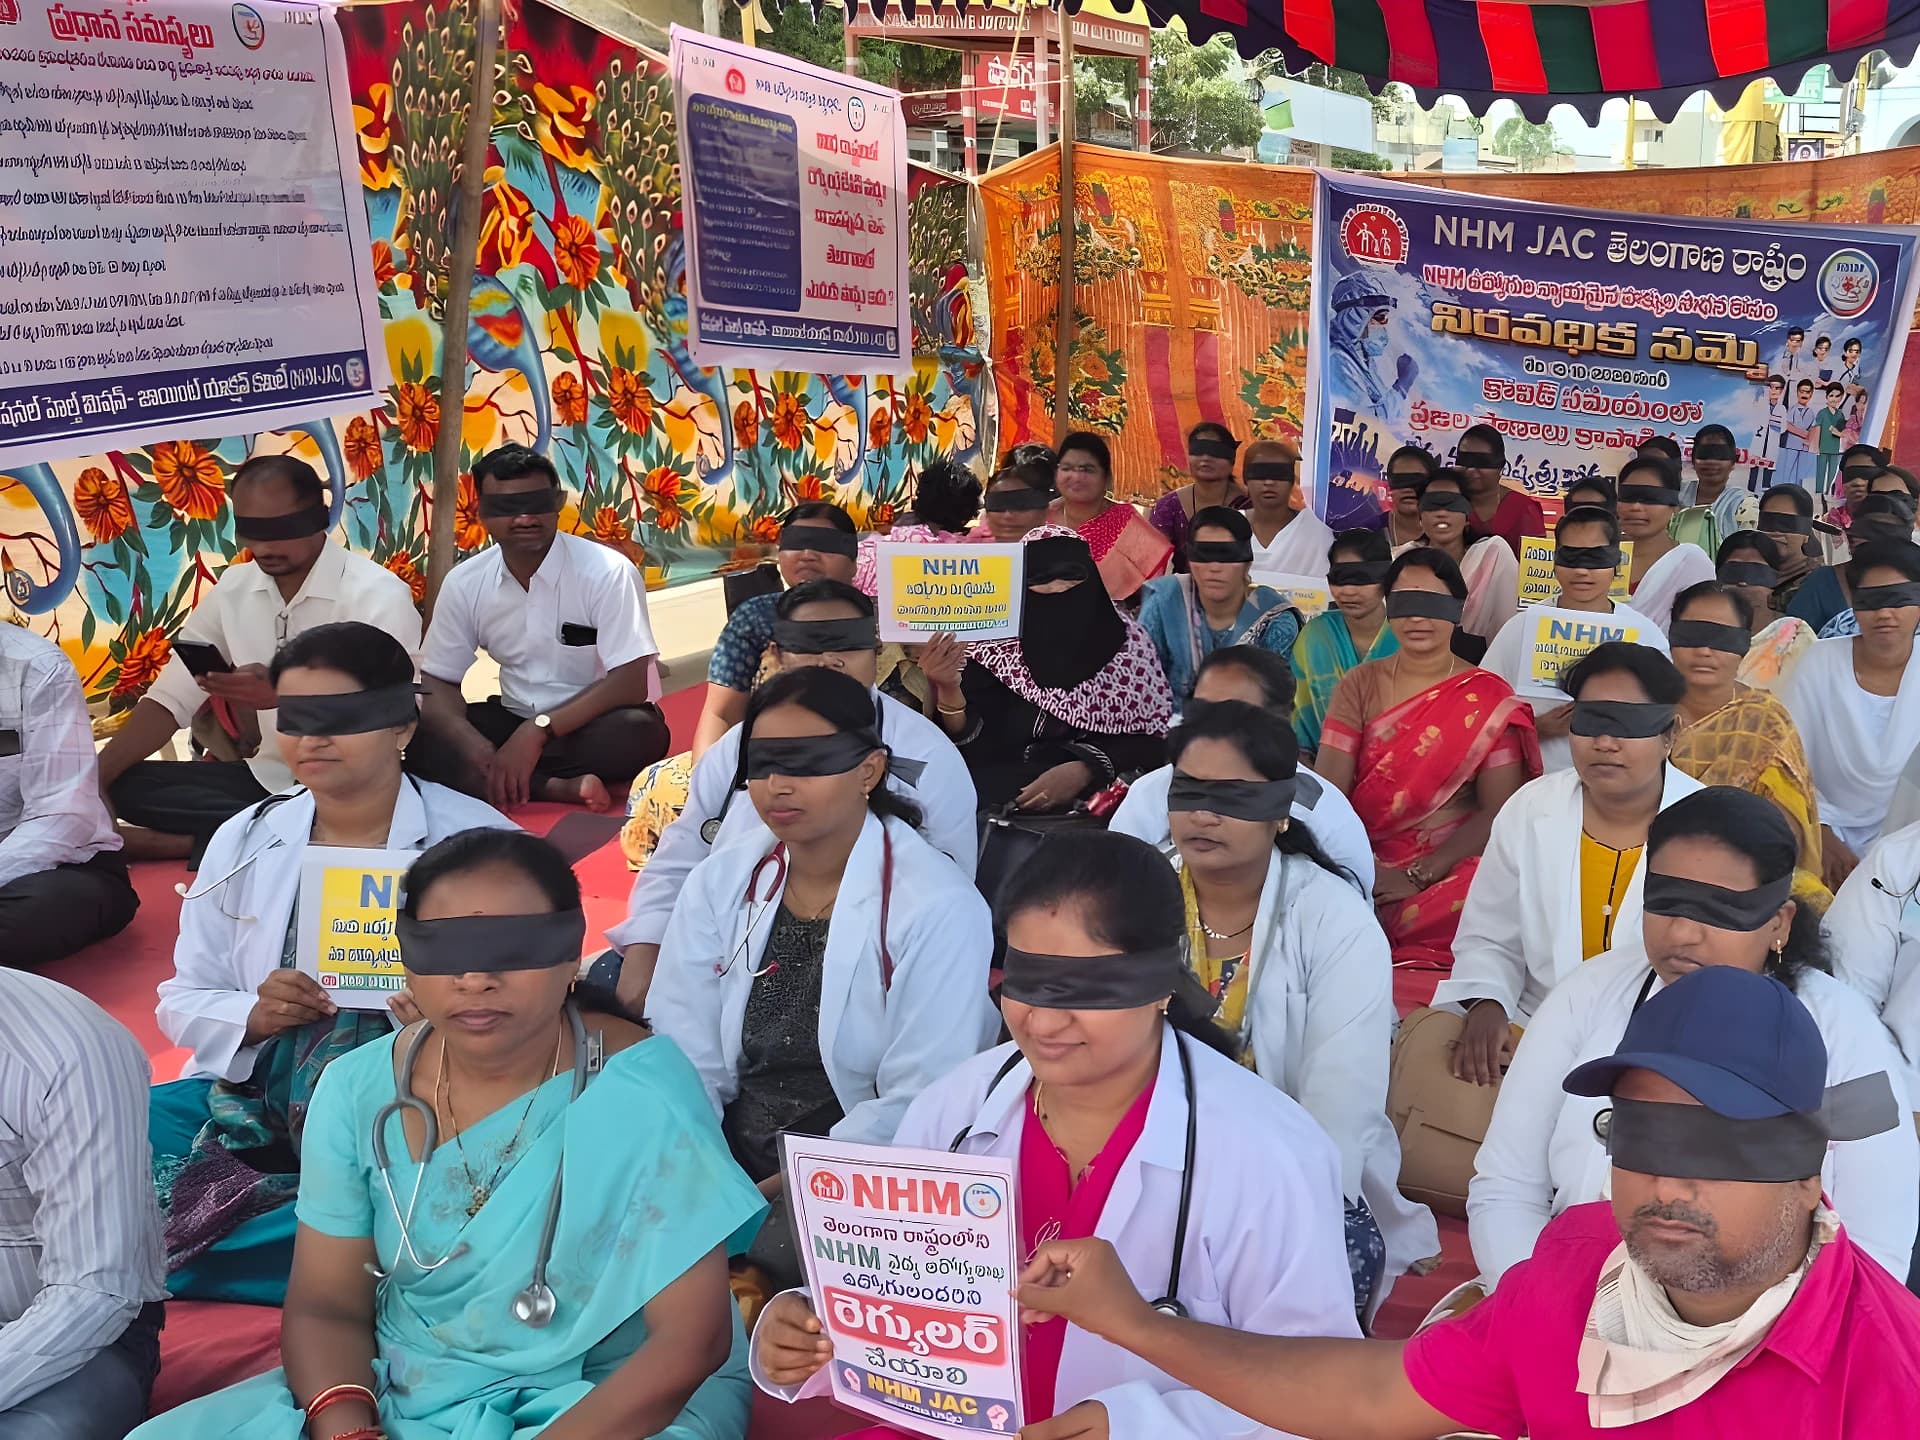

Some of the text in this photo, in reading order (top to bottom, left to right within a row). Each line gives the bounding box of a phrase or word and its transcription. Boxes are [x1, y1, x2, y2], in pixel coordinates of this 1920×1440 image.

[47, 3, 215, 59] ప్రధాన సమస్యలు
[1434, 214, 1515, 253] NHM
[1526, 225, 1597, 260] JAC
[1606, 231, 1725, 274] తెలంగాణ
[1423, 265, 1466, 290] NHM
[1430, 302, 1638, 357] నిరవధిక
[1649, 326, 1769, 380] సమ్మె
[923, 558, 980, 576] NHM
[851, 1173, 962, 1217] NHM
[823, 1216, 898, 1242] తెలంగాణ
[813, 1234, 881, 1271] NHM
[831, 1291, 1000, 1357] రెగ్యులర్
[866, 1372, 923, 1404] NHM
[928, 1389, 979, 1417] JAC
